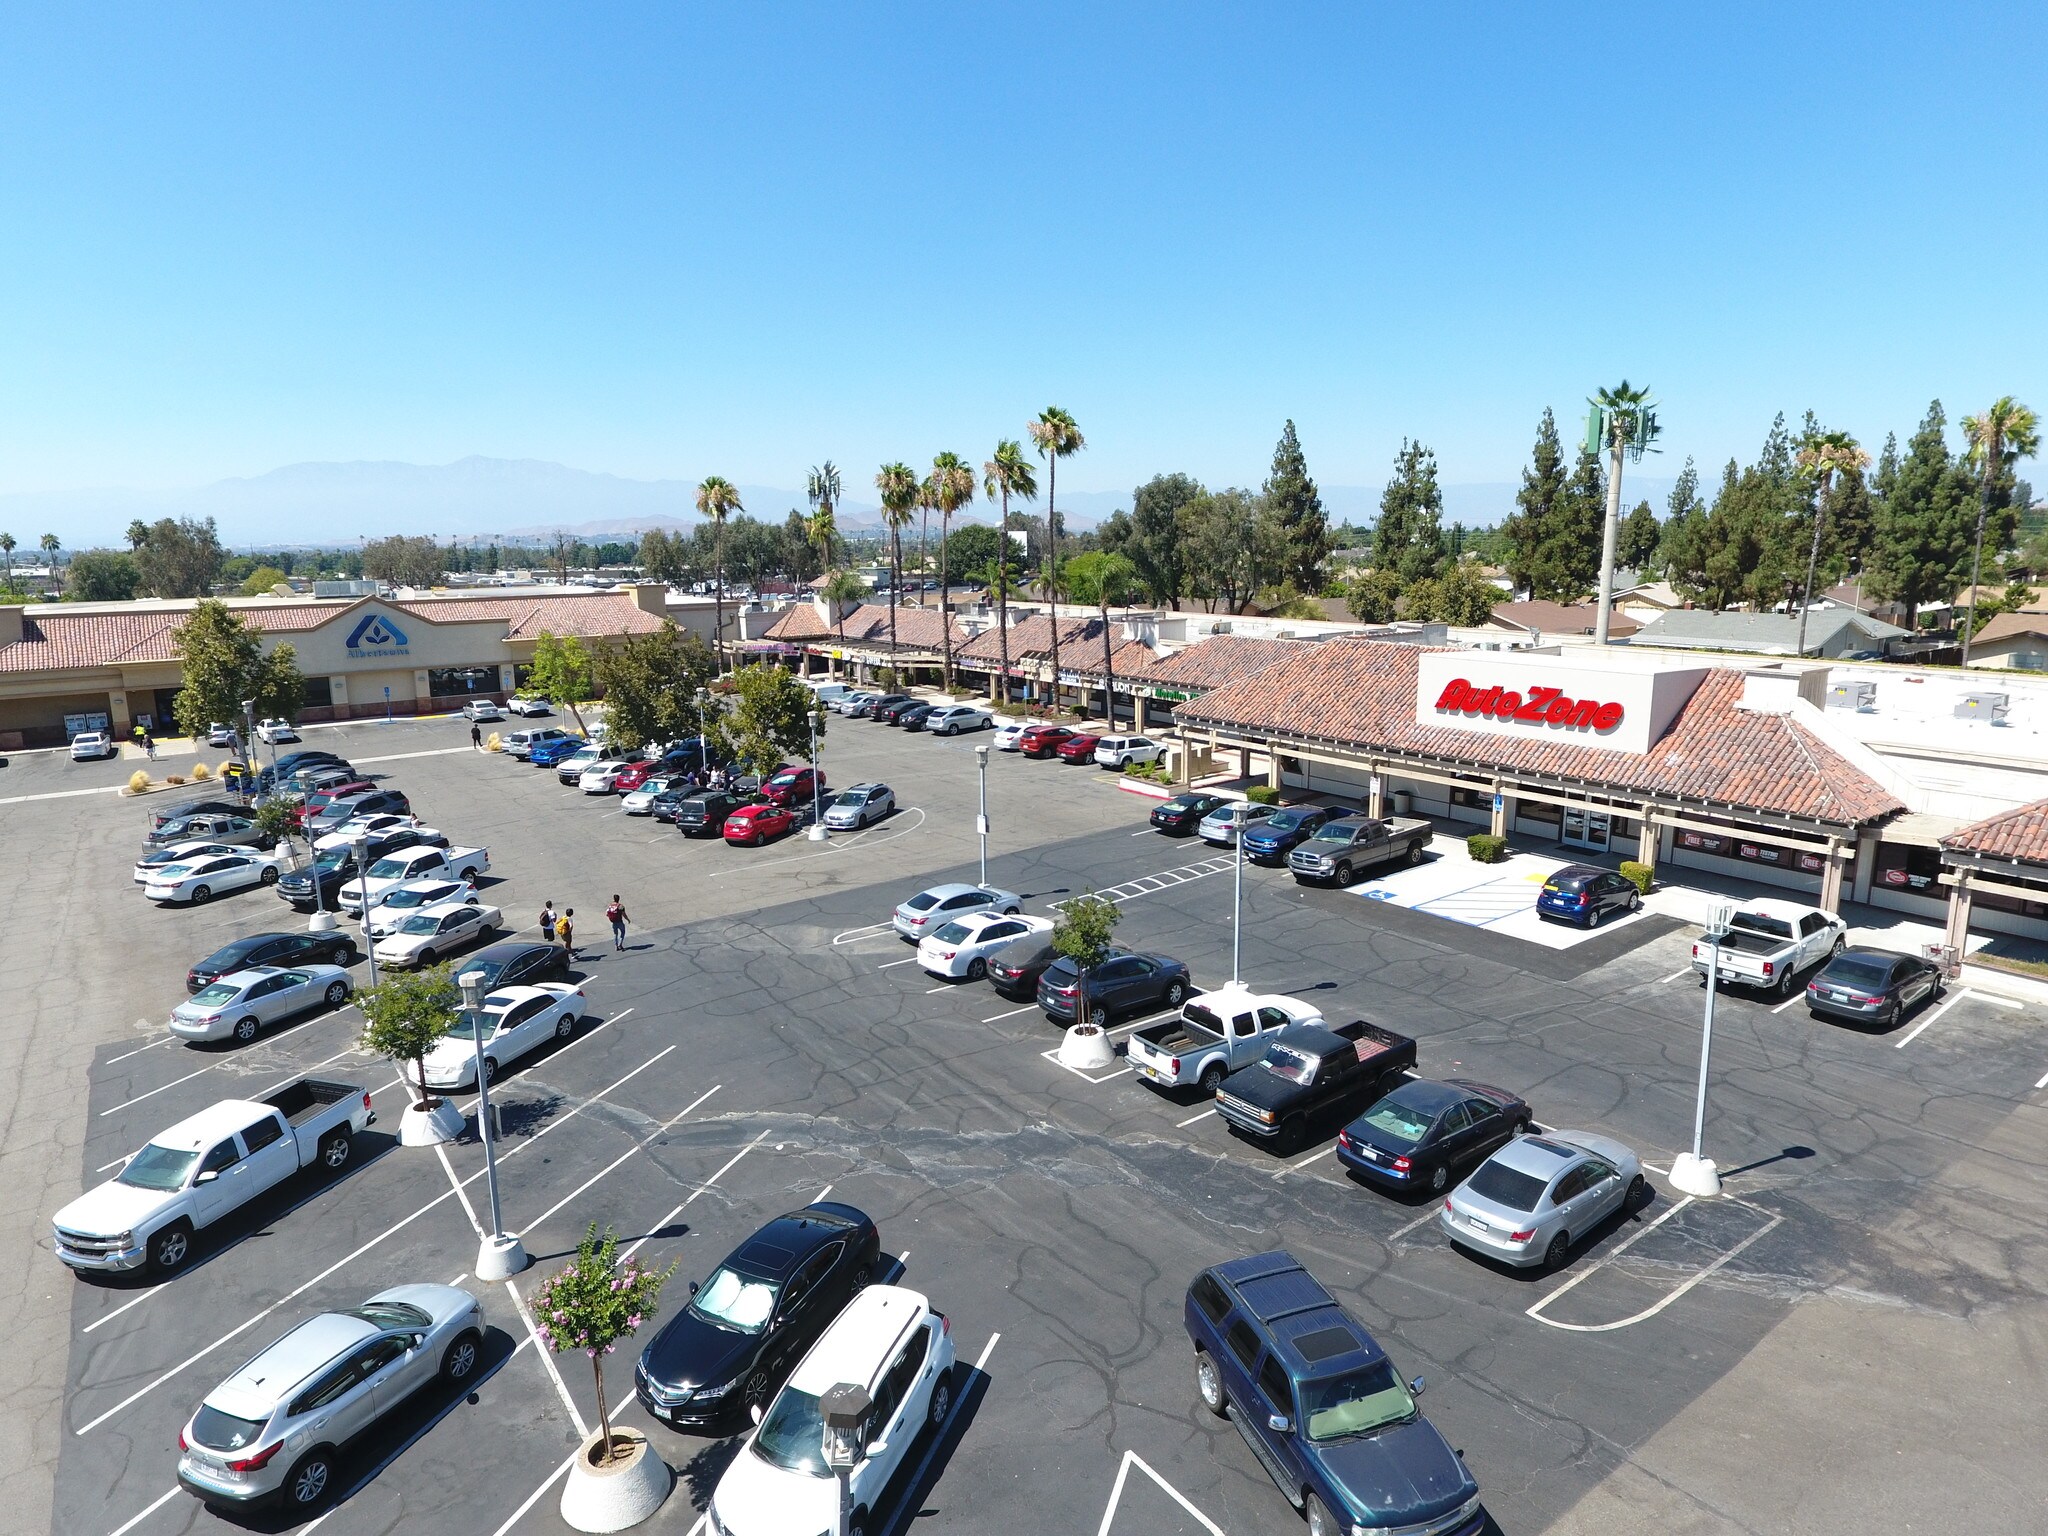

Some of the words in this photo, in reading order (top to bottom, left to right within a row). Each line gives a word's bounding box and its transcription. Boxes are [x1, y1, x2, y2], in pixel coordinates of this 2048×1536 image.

[1434, 678, 1624, 732] AutoZone
[1687, 836, 1700, 846] FREE
[1743, 847, 1758, 857] FREE
[1804, 859, 1819, 869] FREE
